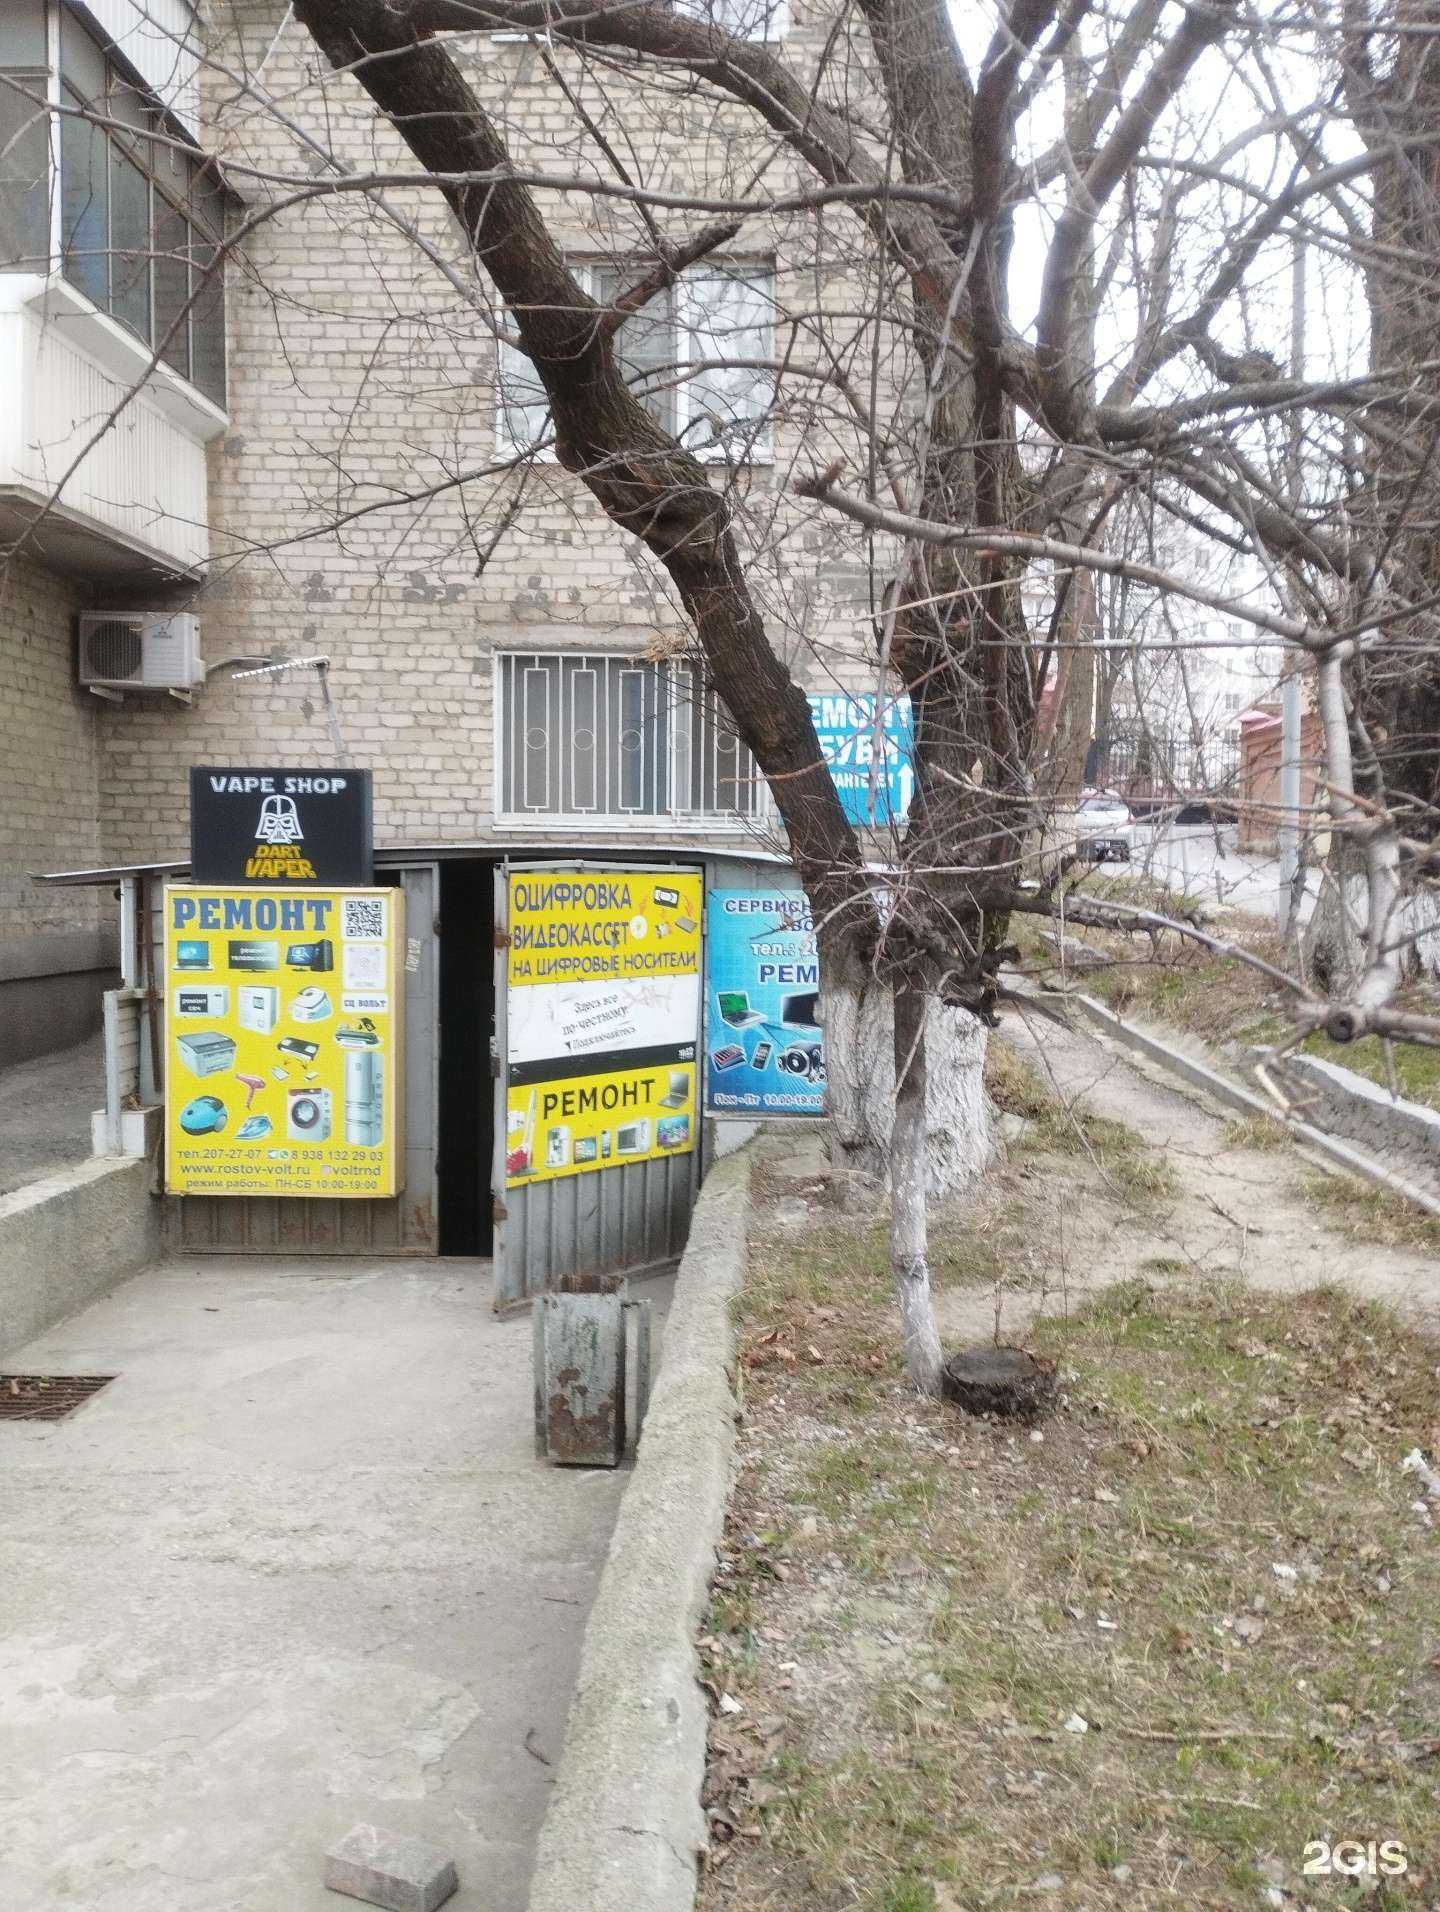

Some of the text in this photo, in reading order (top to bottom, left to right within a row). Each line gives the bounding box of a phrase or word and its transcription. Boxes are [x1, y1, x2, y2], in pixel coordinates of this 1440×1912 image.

[807, 697, 912, 729] ЕМОНТ
[818, 735, 899, 765] БУВИ
[209, 775, 347, 795] VAPE SHOP
[255, 844, 302, 859] DART
[513, 883, 632, 912] ОЦИФРОВКА
[172, 897, 333, 932] РЕМОНТ
[512, 921, 630, 950] ВИДЕОКАССЕТ
[513, 951, 696, 978] НА ЦИФРОВЫЕ НОСИТЕЛИ
[760, 964, 818, 983] РЕМ
[542, 1078, 656, 1120] РЕМОНТ
